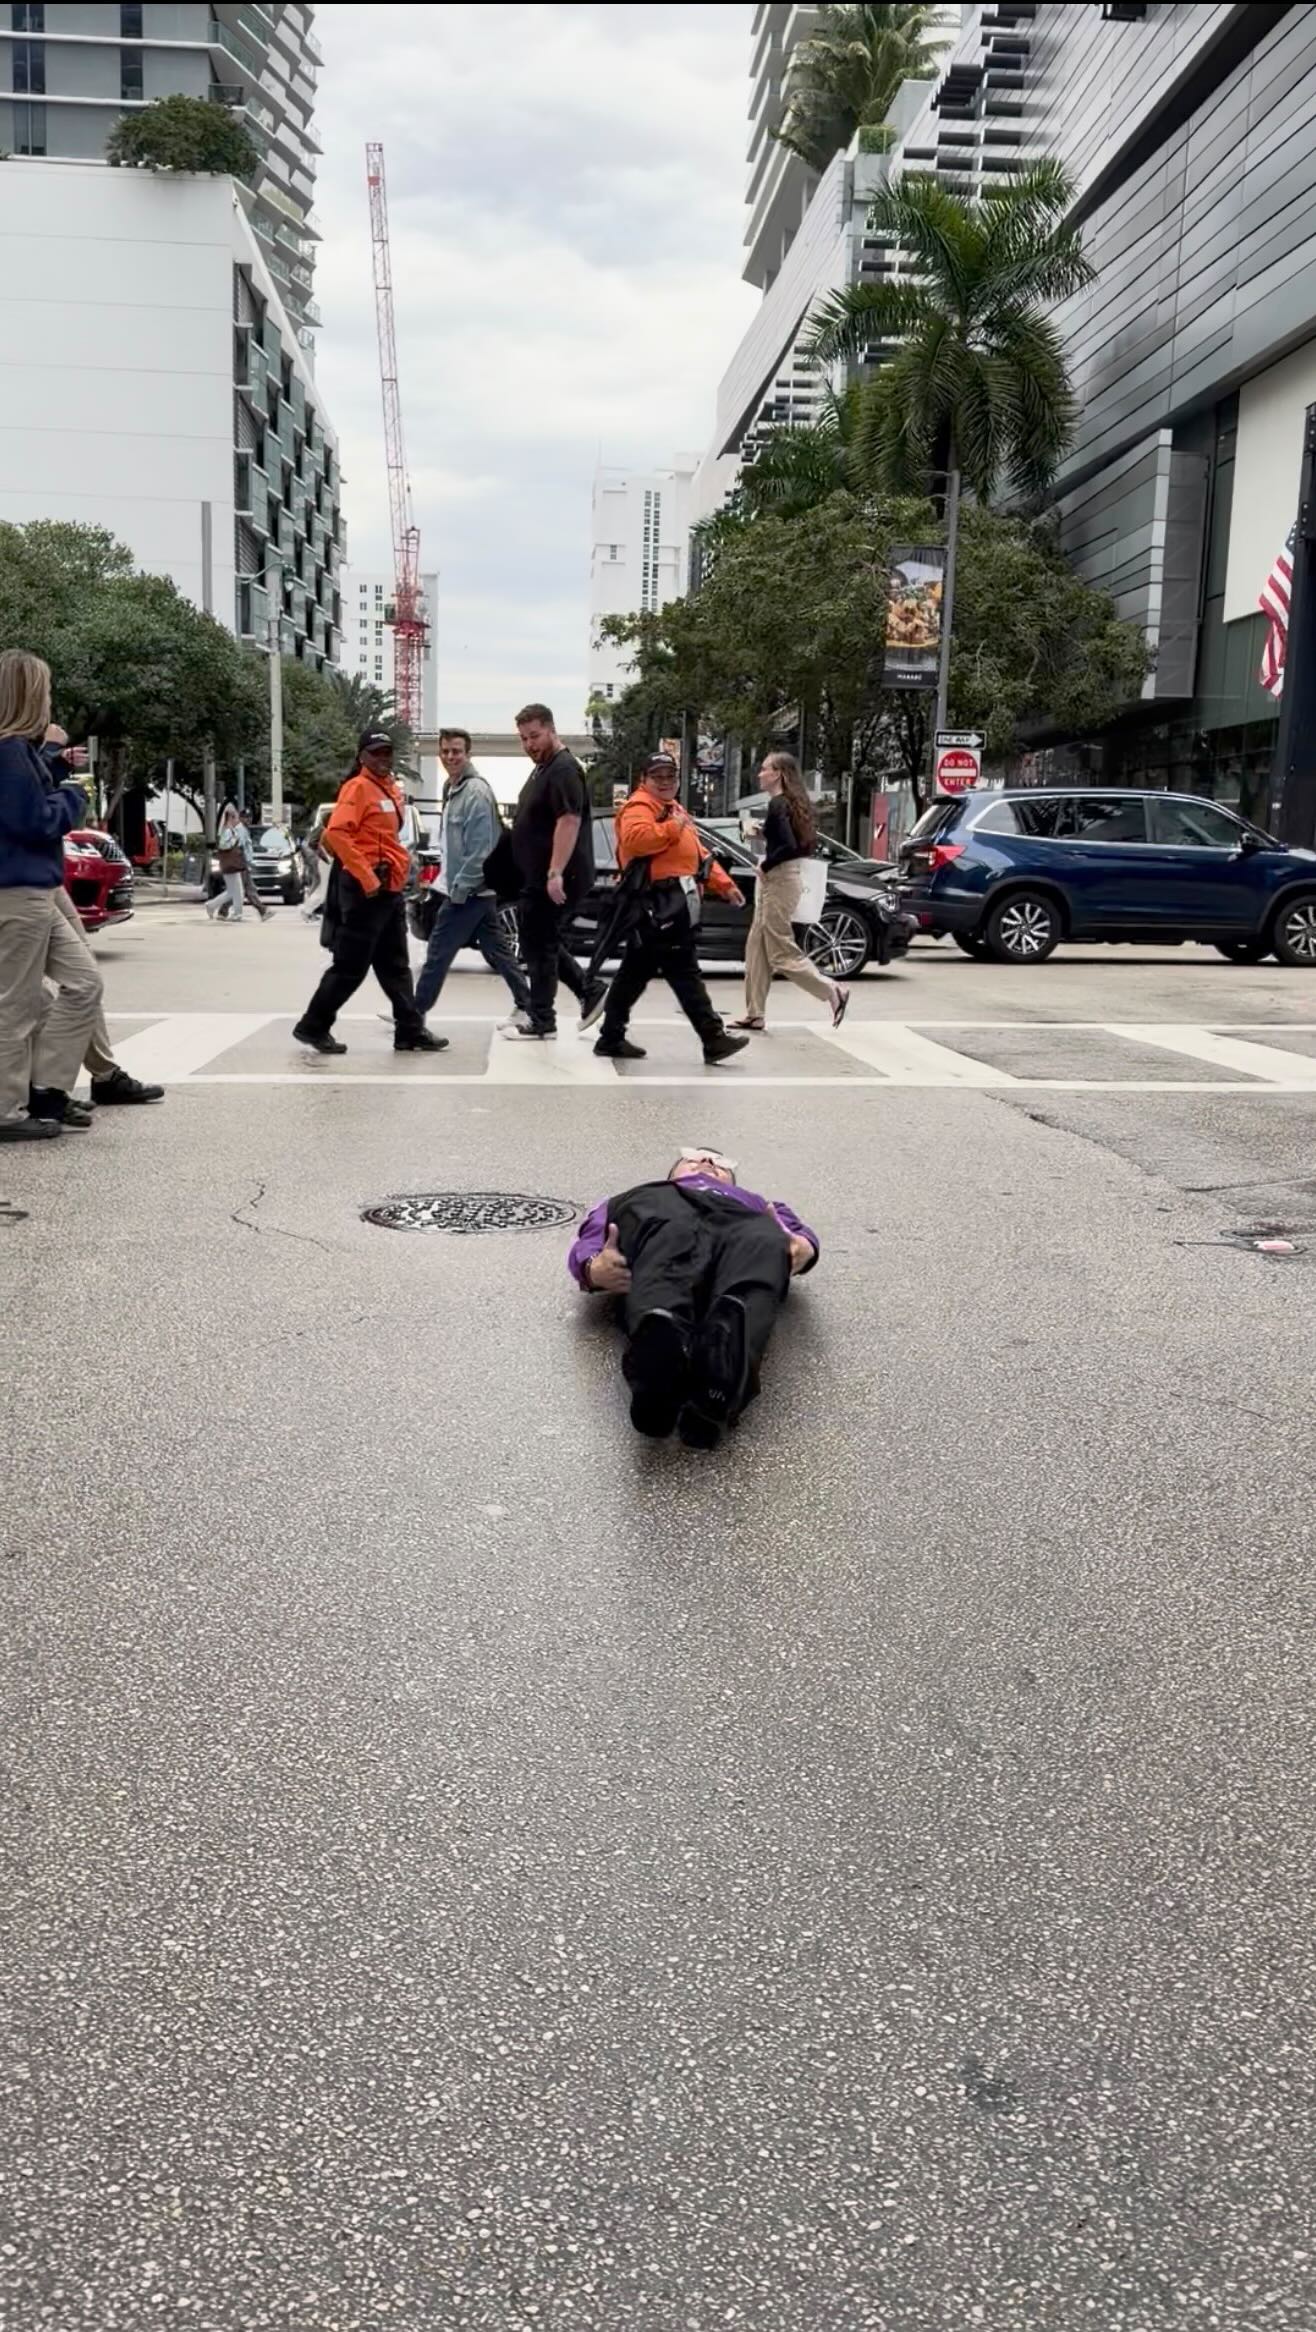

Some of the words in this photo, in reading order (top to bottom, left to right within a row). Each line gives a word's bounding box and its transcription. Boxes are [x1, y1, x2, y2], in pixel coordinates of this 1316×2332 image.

[939, 735, 952, 745] ONE
[954, 735, 971, 745] WAY
[943, 758, 955, 767] DO
[957, 758, 973, 767] NOT
[943, 778, 972, 786] ENTER
